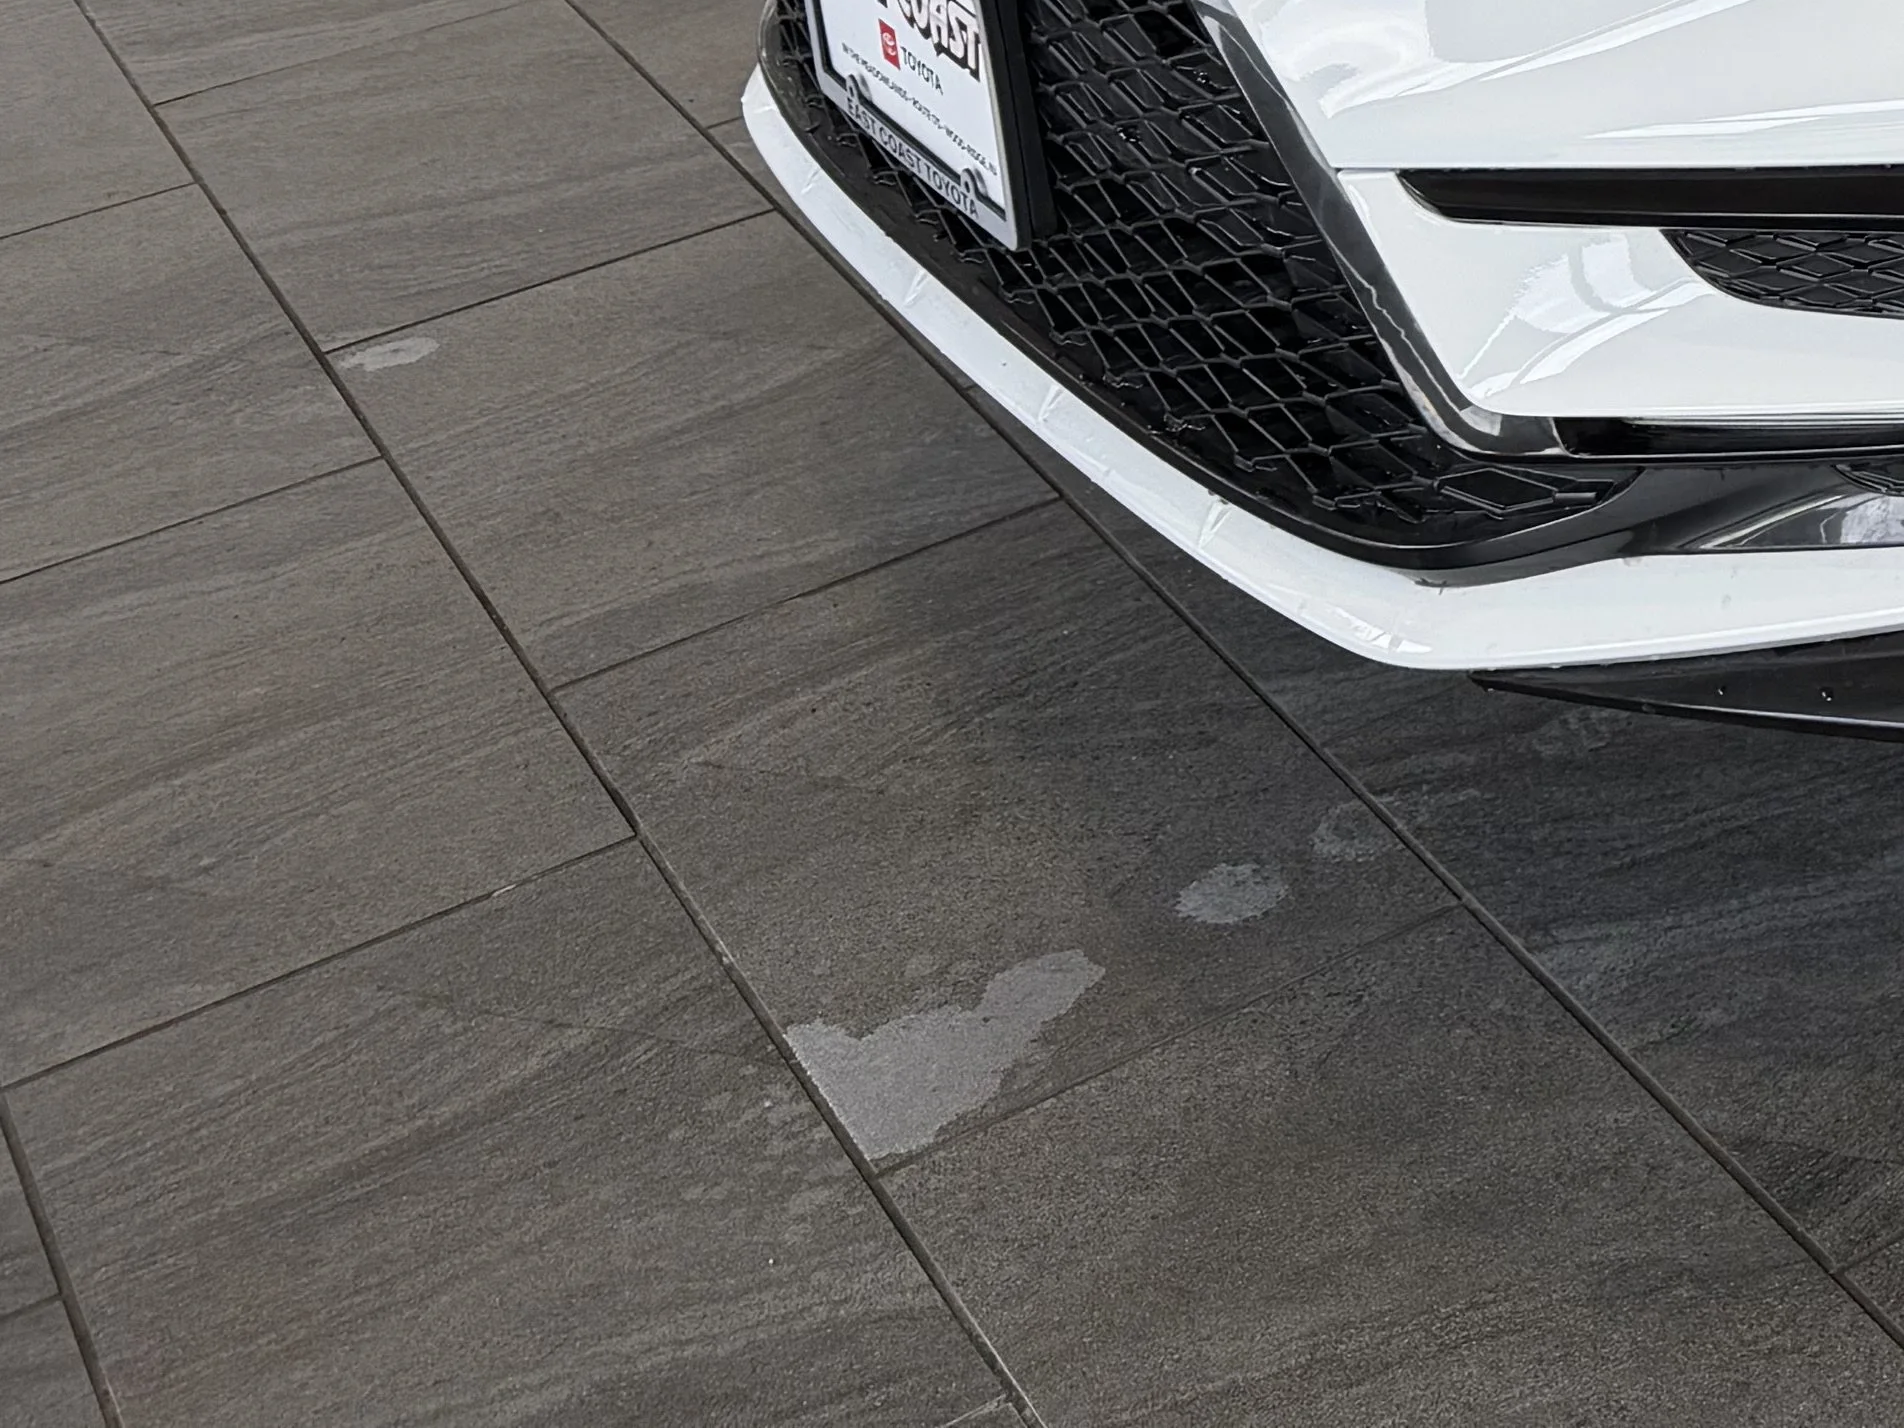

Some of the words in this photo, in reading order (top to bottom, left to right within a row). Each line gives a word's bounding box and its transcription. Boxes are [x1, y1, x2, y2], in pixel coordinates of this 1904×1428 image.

[901, 46, 943, 95] TOYOTA
[847, 97, 877, 135] EAST
[879, 127, 922, 173] COAST
[924, 164, 980, 220] TOYOTA
